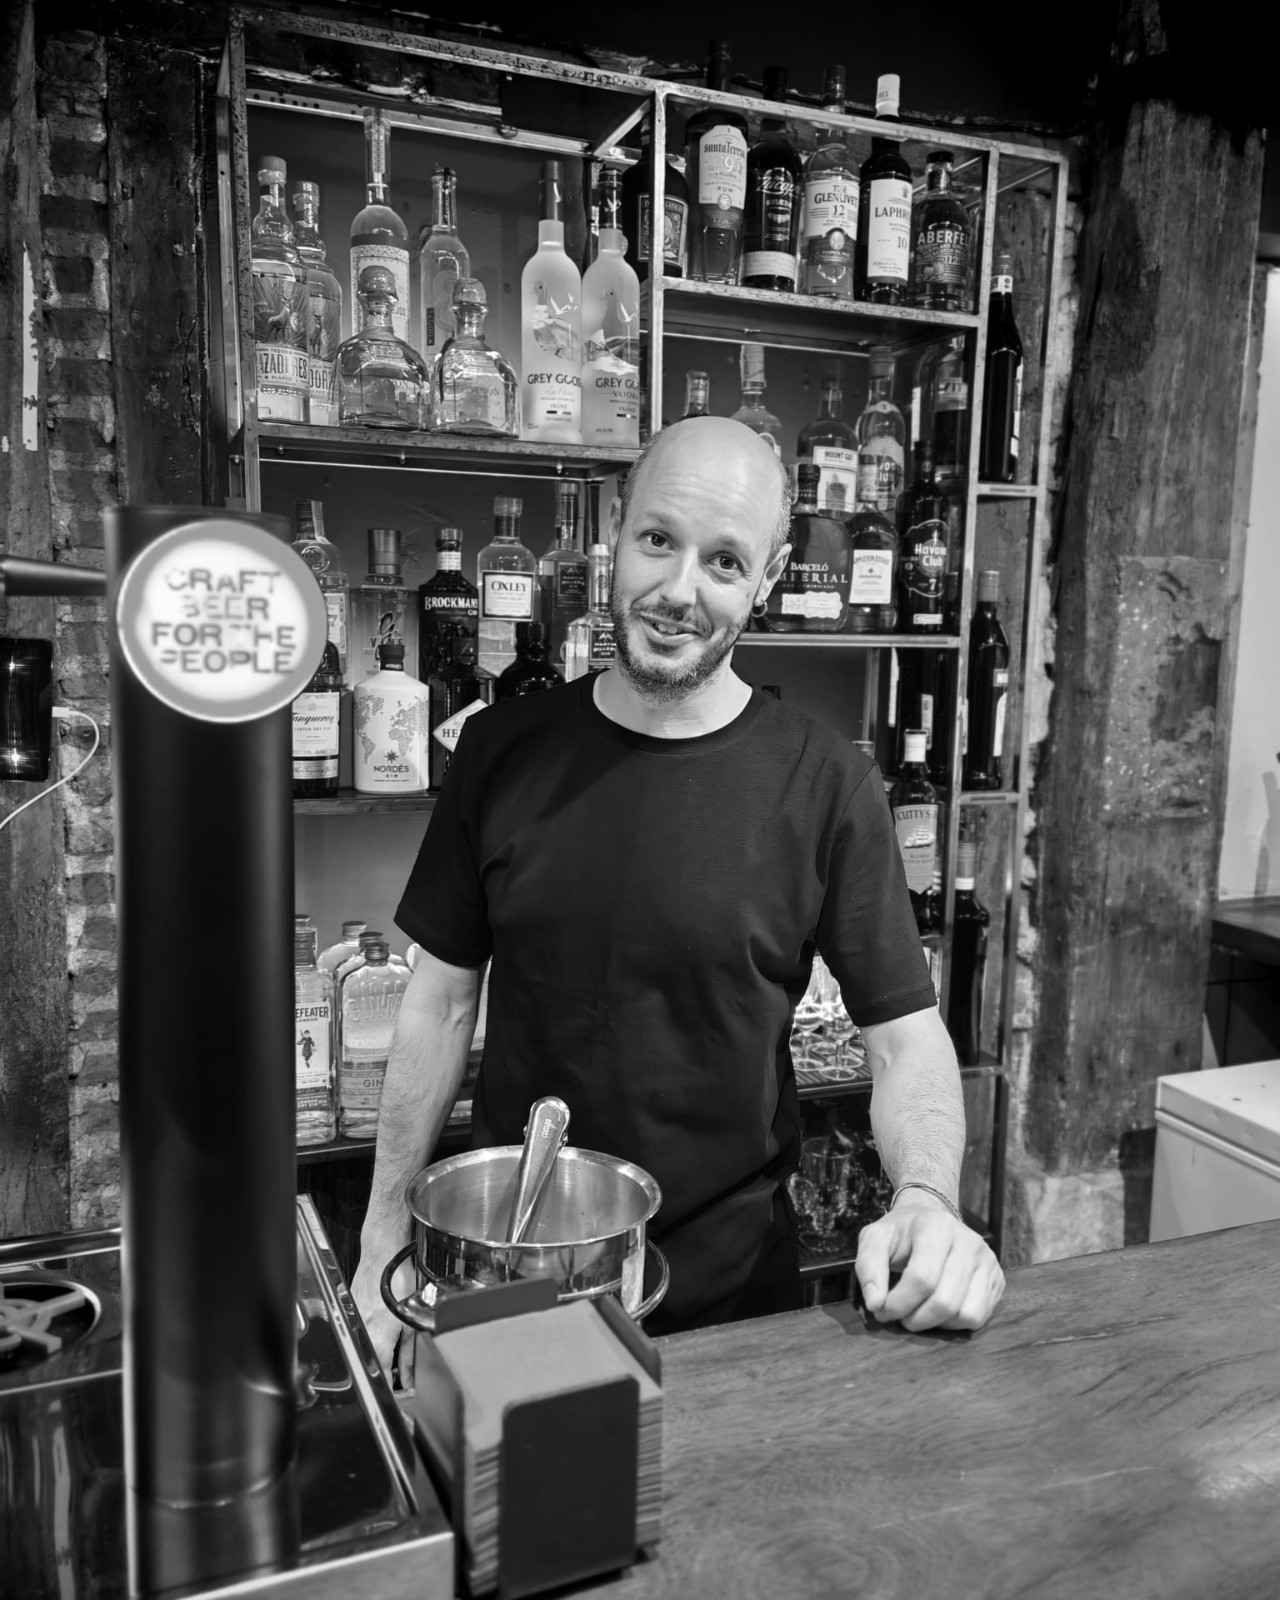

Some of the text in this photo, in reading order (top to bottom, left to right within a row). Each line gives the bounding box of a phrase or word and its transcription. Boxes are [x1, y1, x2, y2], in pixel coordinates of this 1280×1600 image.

[833, 205, 845, 216] 12
[527, 373, 552, 385] GREY
[595, 377, 623, 389] GREY
[166, 567, 281, 593] CRAFT
[490, 580, 527, 592] OXLEY
[928, 577, 937, 591] 7
[151, 621, 223, 647] FOR
[159, 649, 294, 674] PEOPLE
